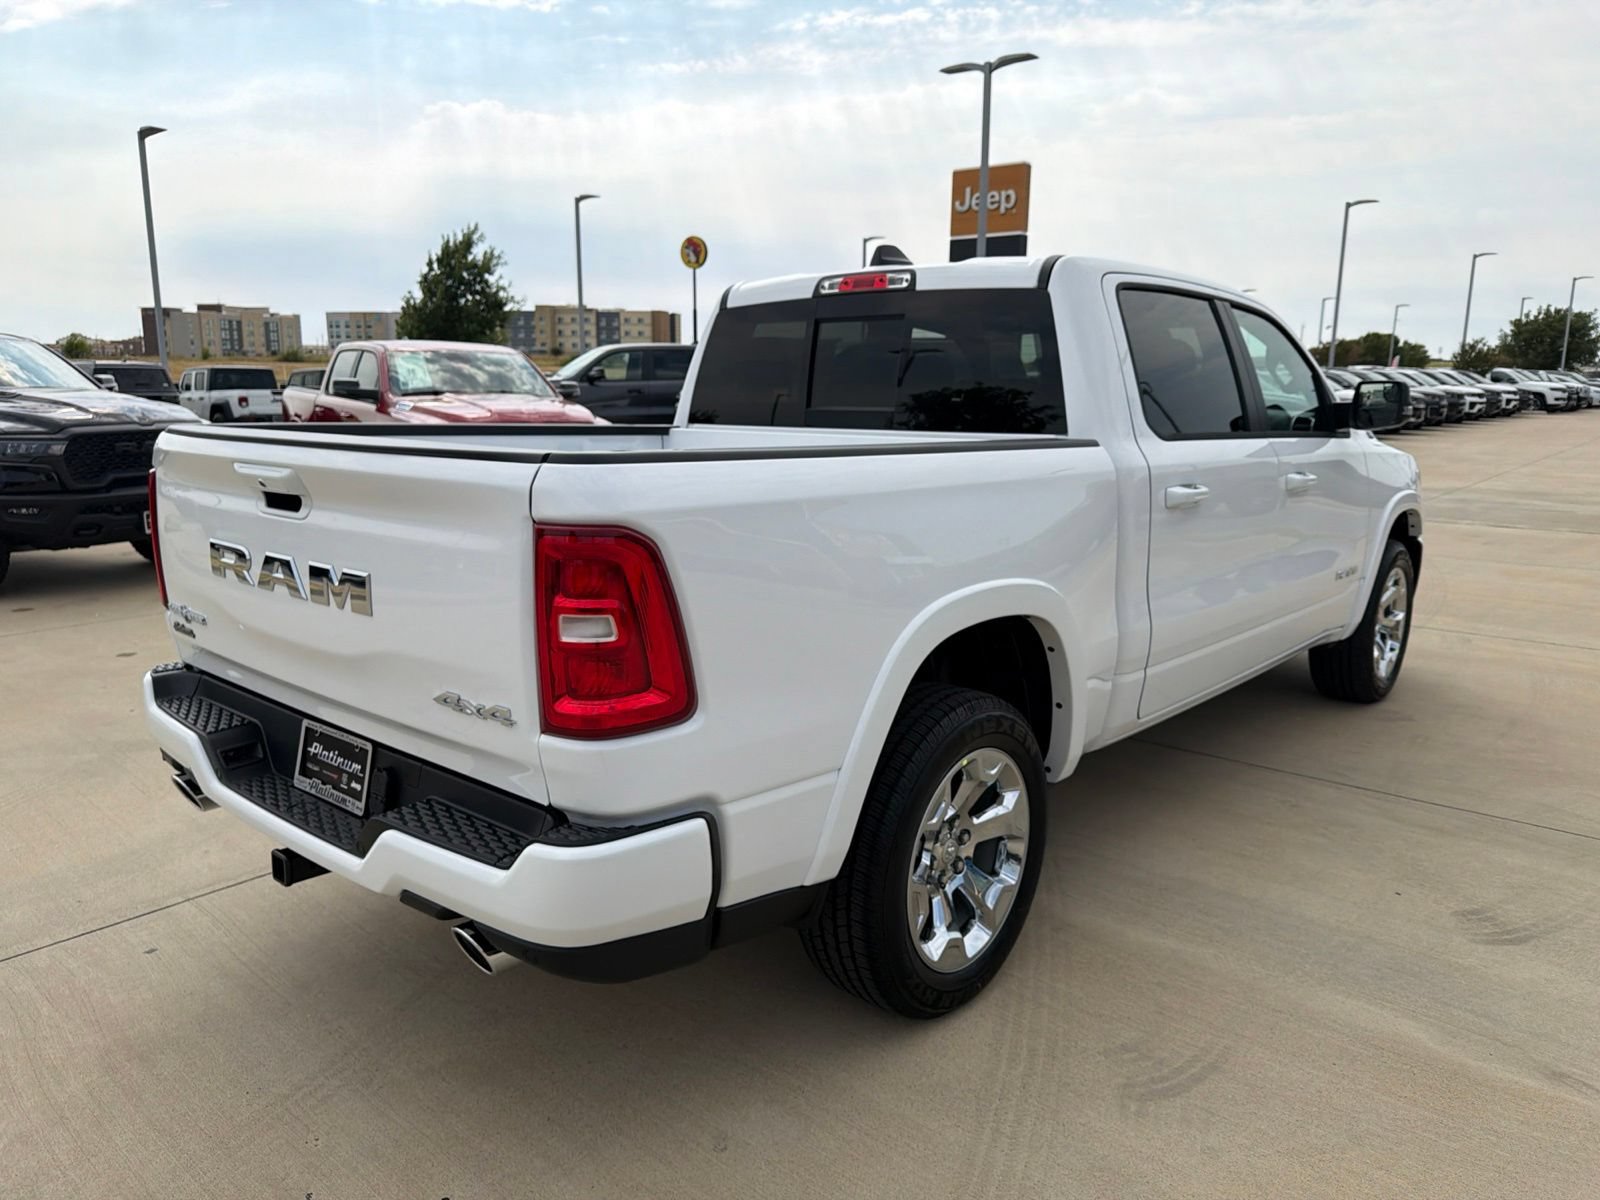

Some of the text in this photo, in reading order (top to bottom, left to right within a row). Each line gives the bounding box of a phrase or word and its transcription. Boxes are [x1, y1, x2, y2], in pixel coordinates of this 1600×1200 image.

[954, 186, 1017, 214] Jeep
[209, 538, 373, 617] RAM
[307, 741, 364, 777] Platinum
[309, 780, 351, 807] Platinum
